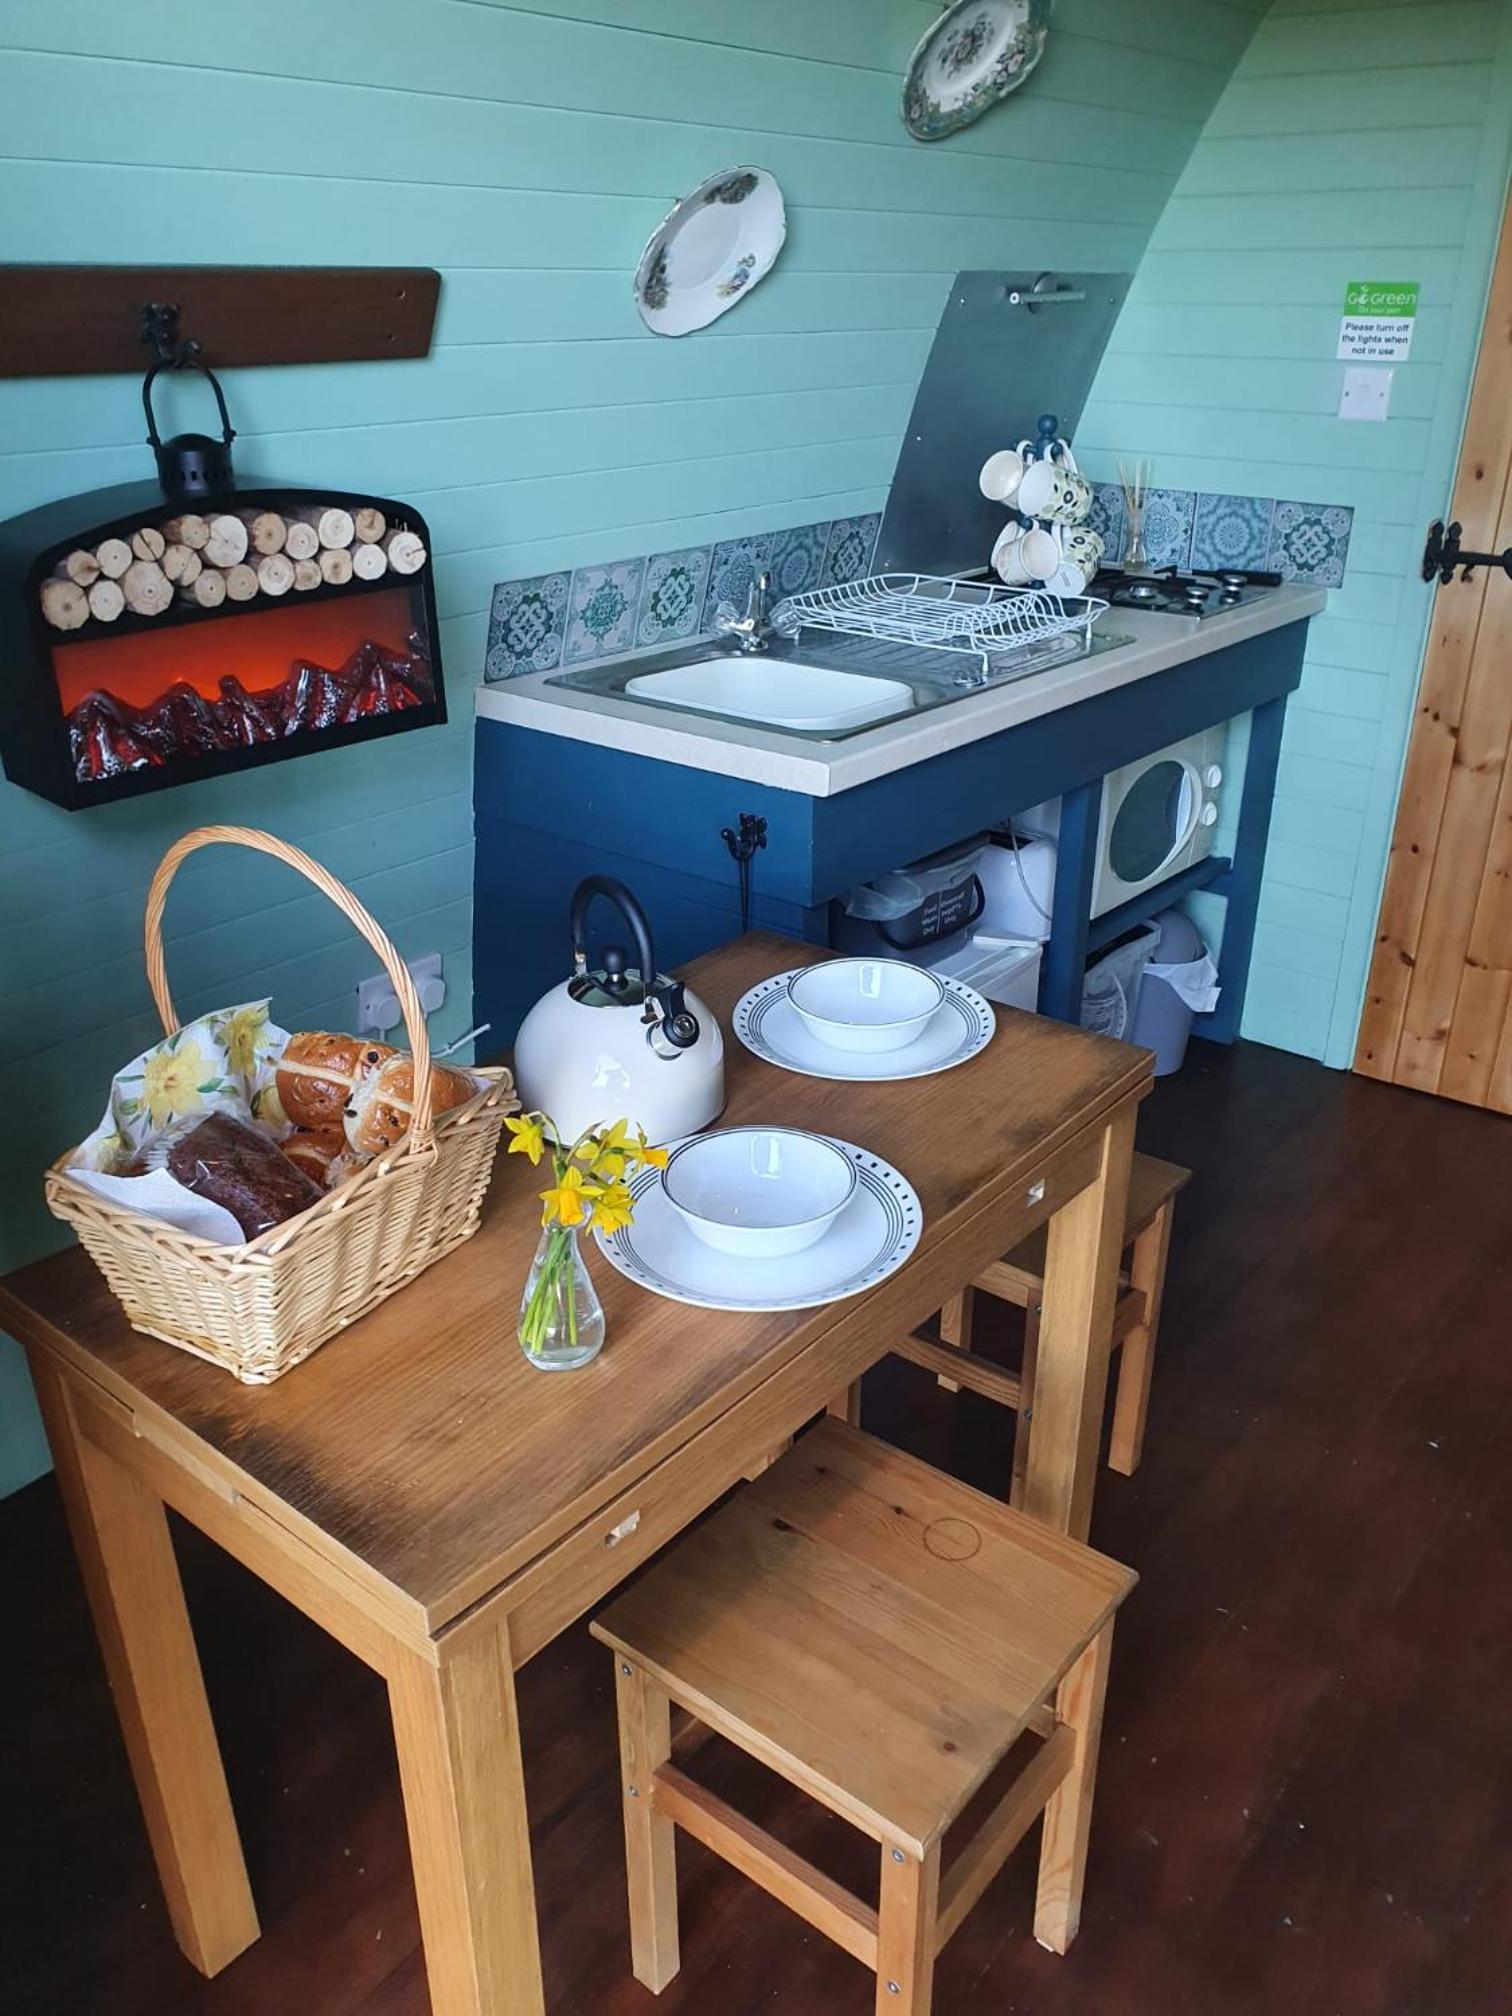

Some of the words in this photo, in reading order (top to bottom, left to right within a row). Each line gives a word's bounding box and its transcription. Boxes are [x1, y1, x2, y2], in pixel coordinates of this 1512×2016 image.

[1345, 322, 1375, 333] Please
[1376, 324, 1395, 333] turn
[1396, 324, 1410, 333] off
[1342, 335, 1356, 343] the
[1357, 334, 1382, 345] lights
[1384, 336, 1409, 344] when
[1351, 347, 1366, 355] not
[1378, 348, 1395, 356] use
